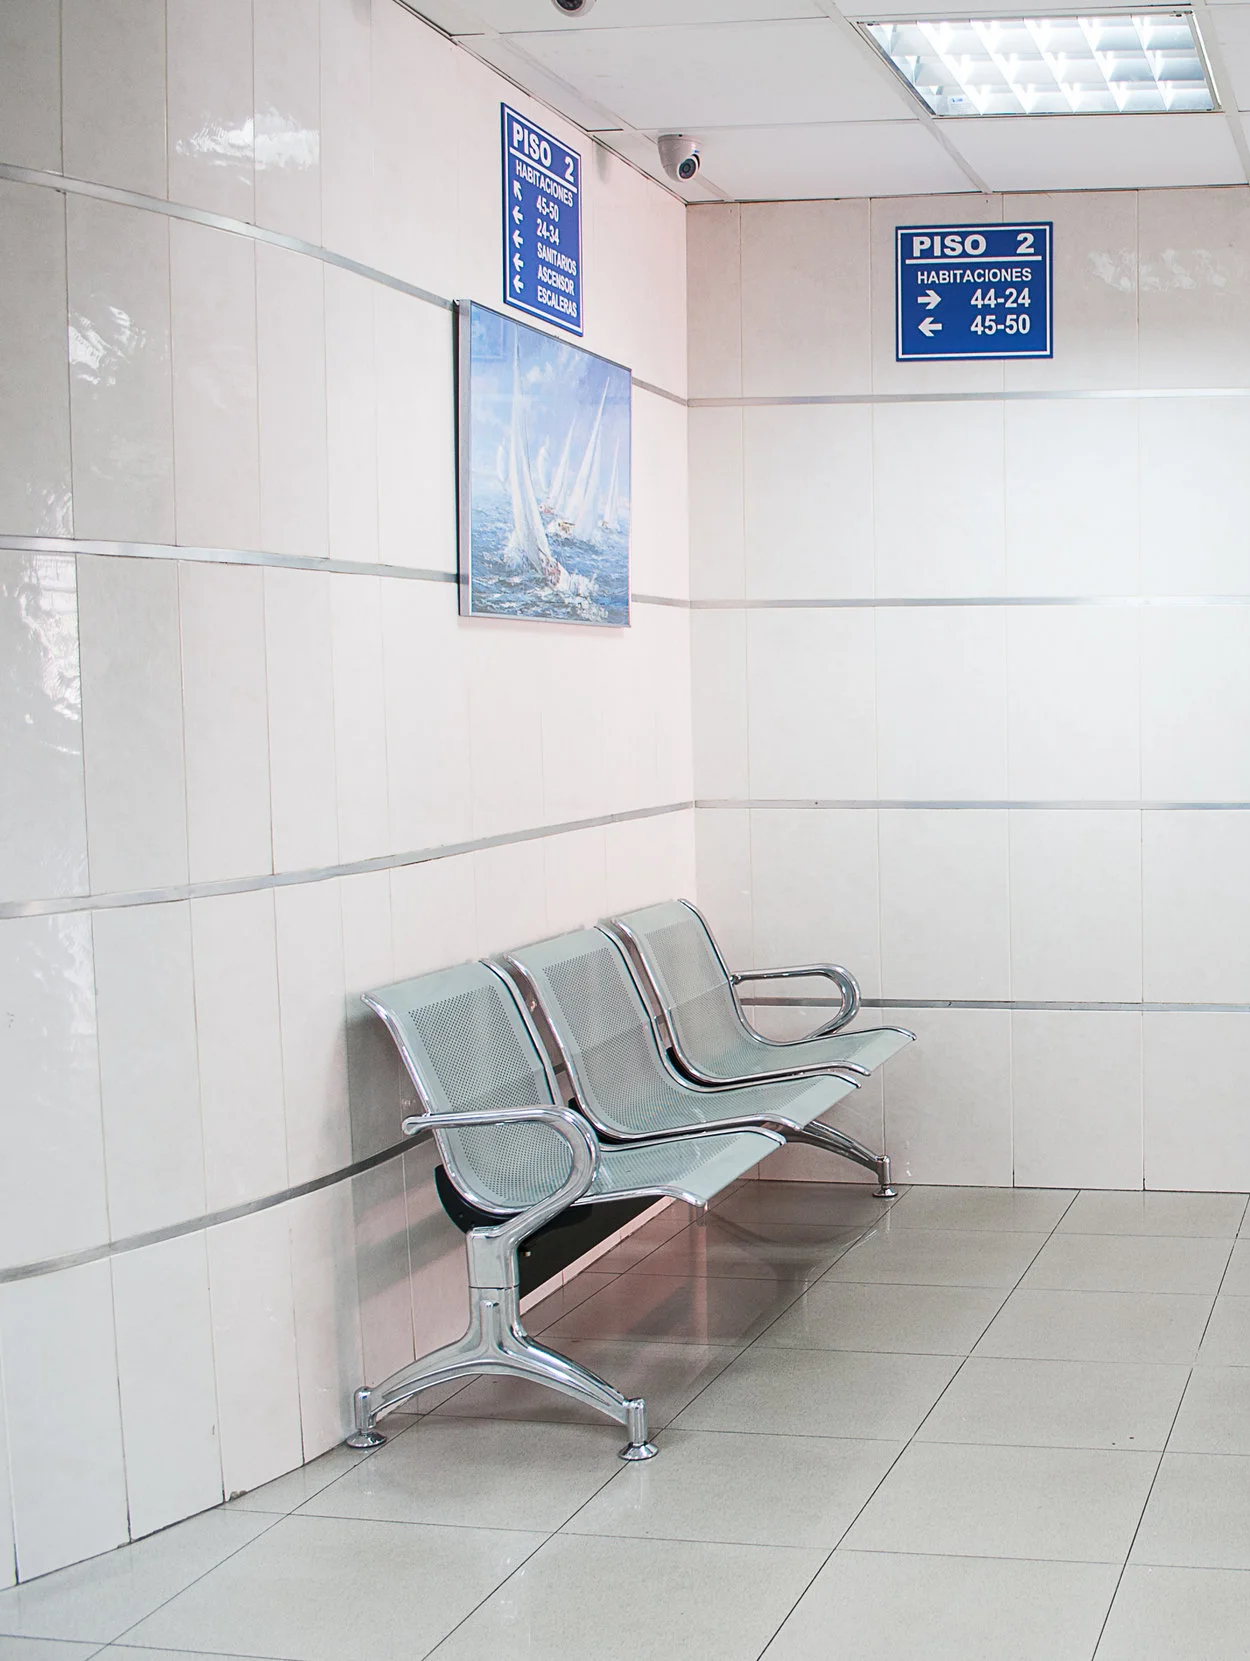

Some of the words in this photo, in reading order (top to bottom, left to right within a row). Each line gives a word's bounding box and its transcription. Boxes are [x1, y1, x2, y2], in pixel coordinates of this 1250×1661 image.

[512, 121, 553, 167] PISO
[564, 157, 575, 183] 2
[515, 160, 574, 207] HABITACIONES
[536, 195, 559, 222] 45-50
[536, 218, 560, 246] 24-34
[912, 234, 987, 257] PISO
[1016, 233, 1035, 254] 2
[537, 242, 577, 276] SANITARIOS
[537, 265, 575, 296] ASCENSOR
[917, 268, 1032, 284] HABITACIONES
[537, 285, 577, 318] ESCALERAS
[970, 288, 1031, 309] 44-24
[970, 314, 1031, 335] 45-50
